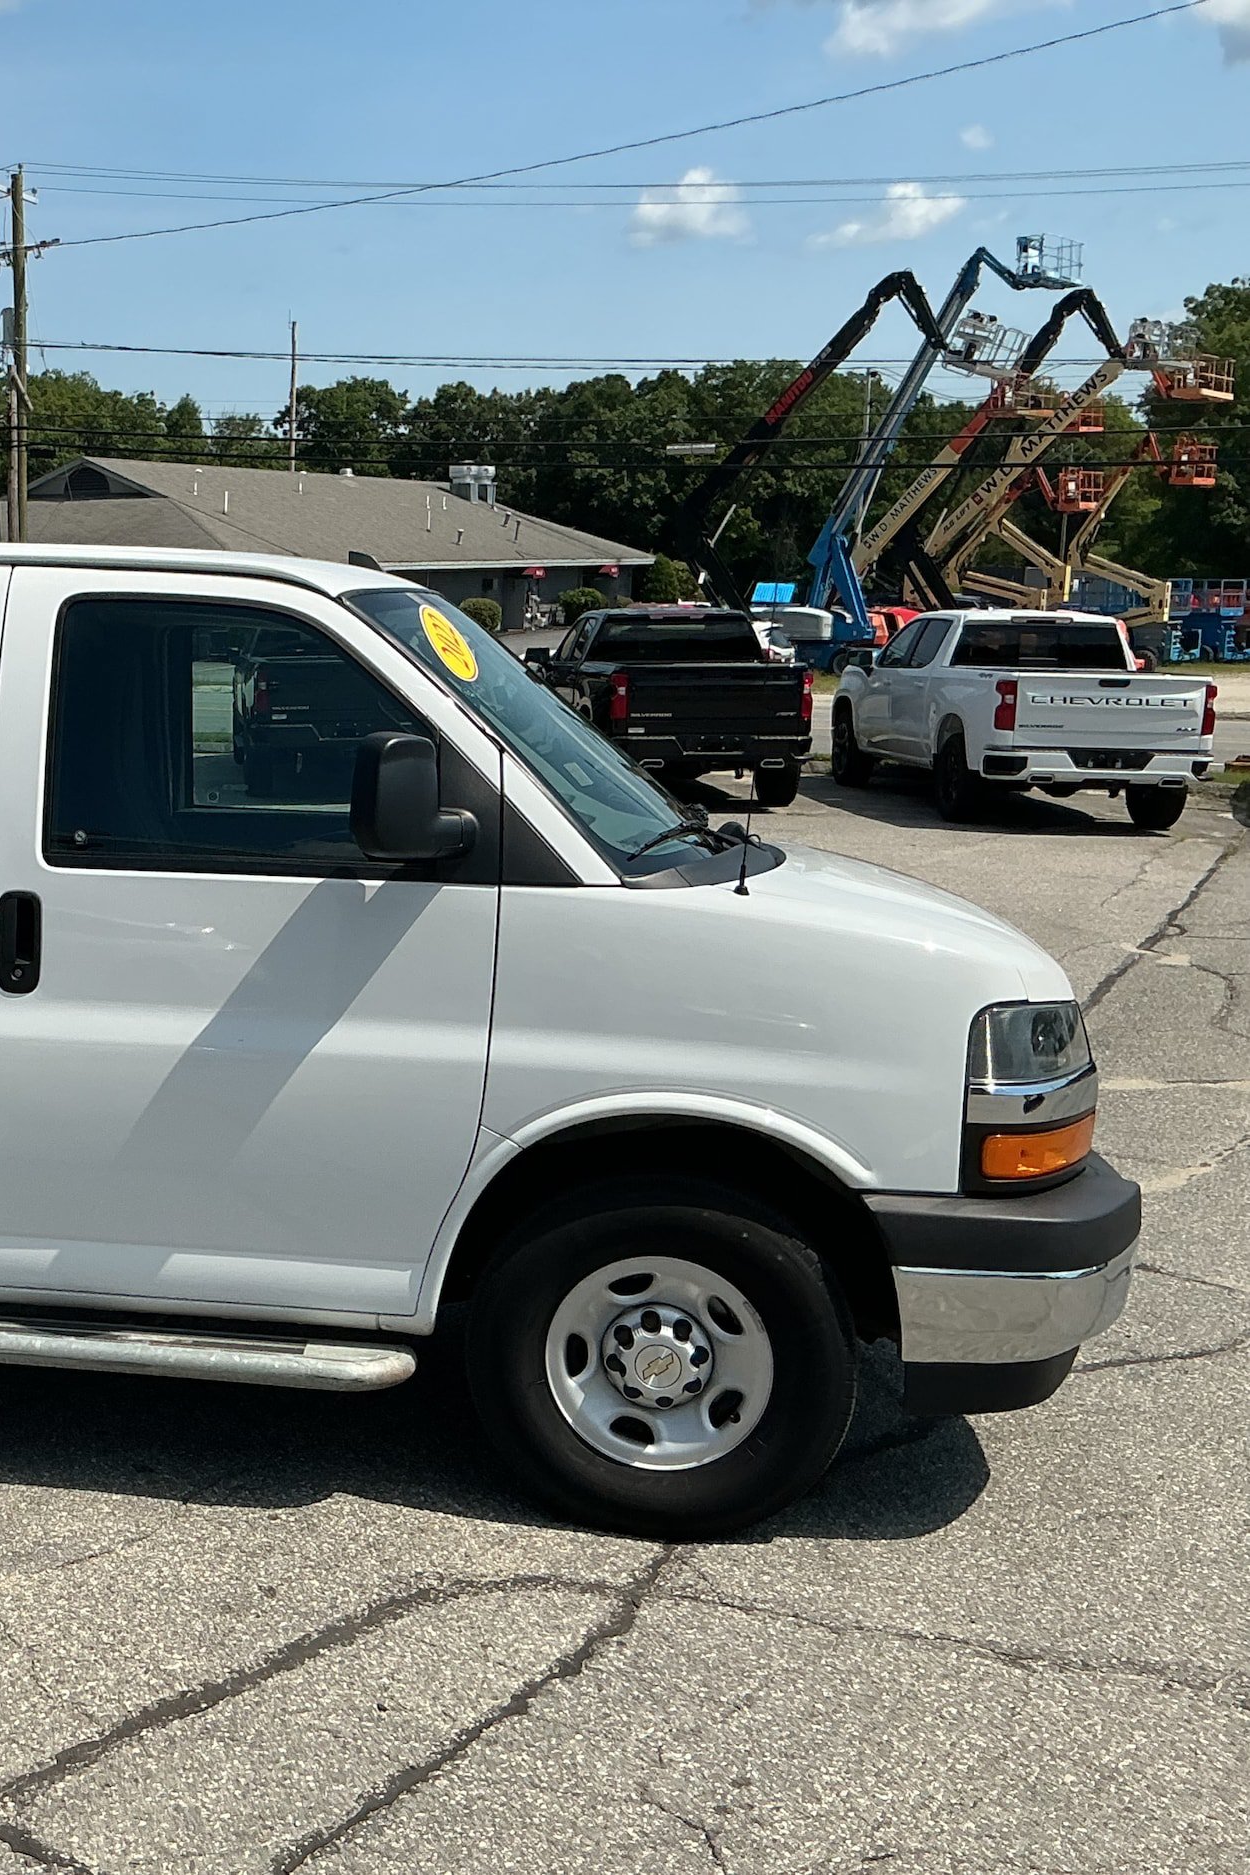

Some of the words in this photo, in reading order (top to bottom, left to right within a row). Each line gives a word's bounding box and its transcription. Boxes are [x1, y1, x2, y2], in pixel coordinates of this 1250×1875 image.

[765, 369, 814, 426] MANITOU
[1021, 370, 1109, 458] MATTHEWS
[890, 468, 938, 521] MATTHEWS
[1030, 695, 1194, 708] CHEVROLET
